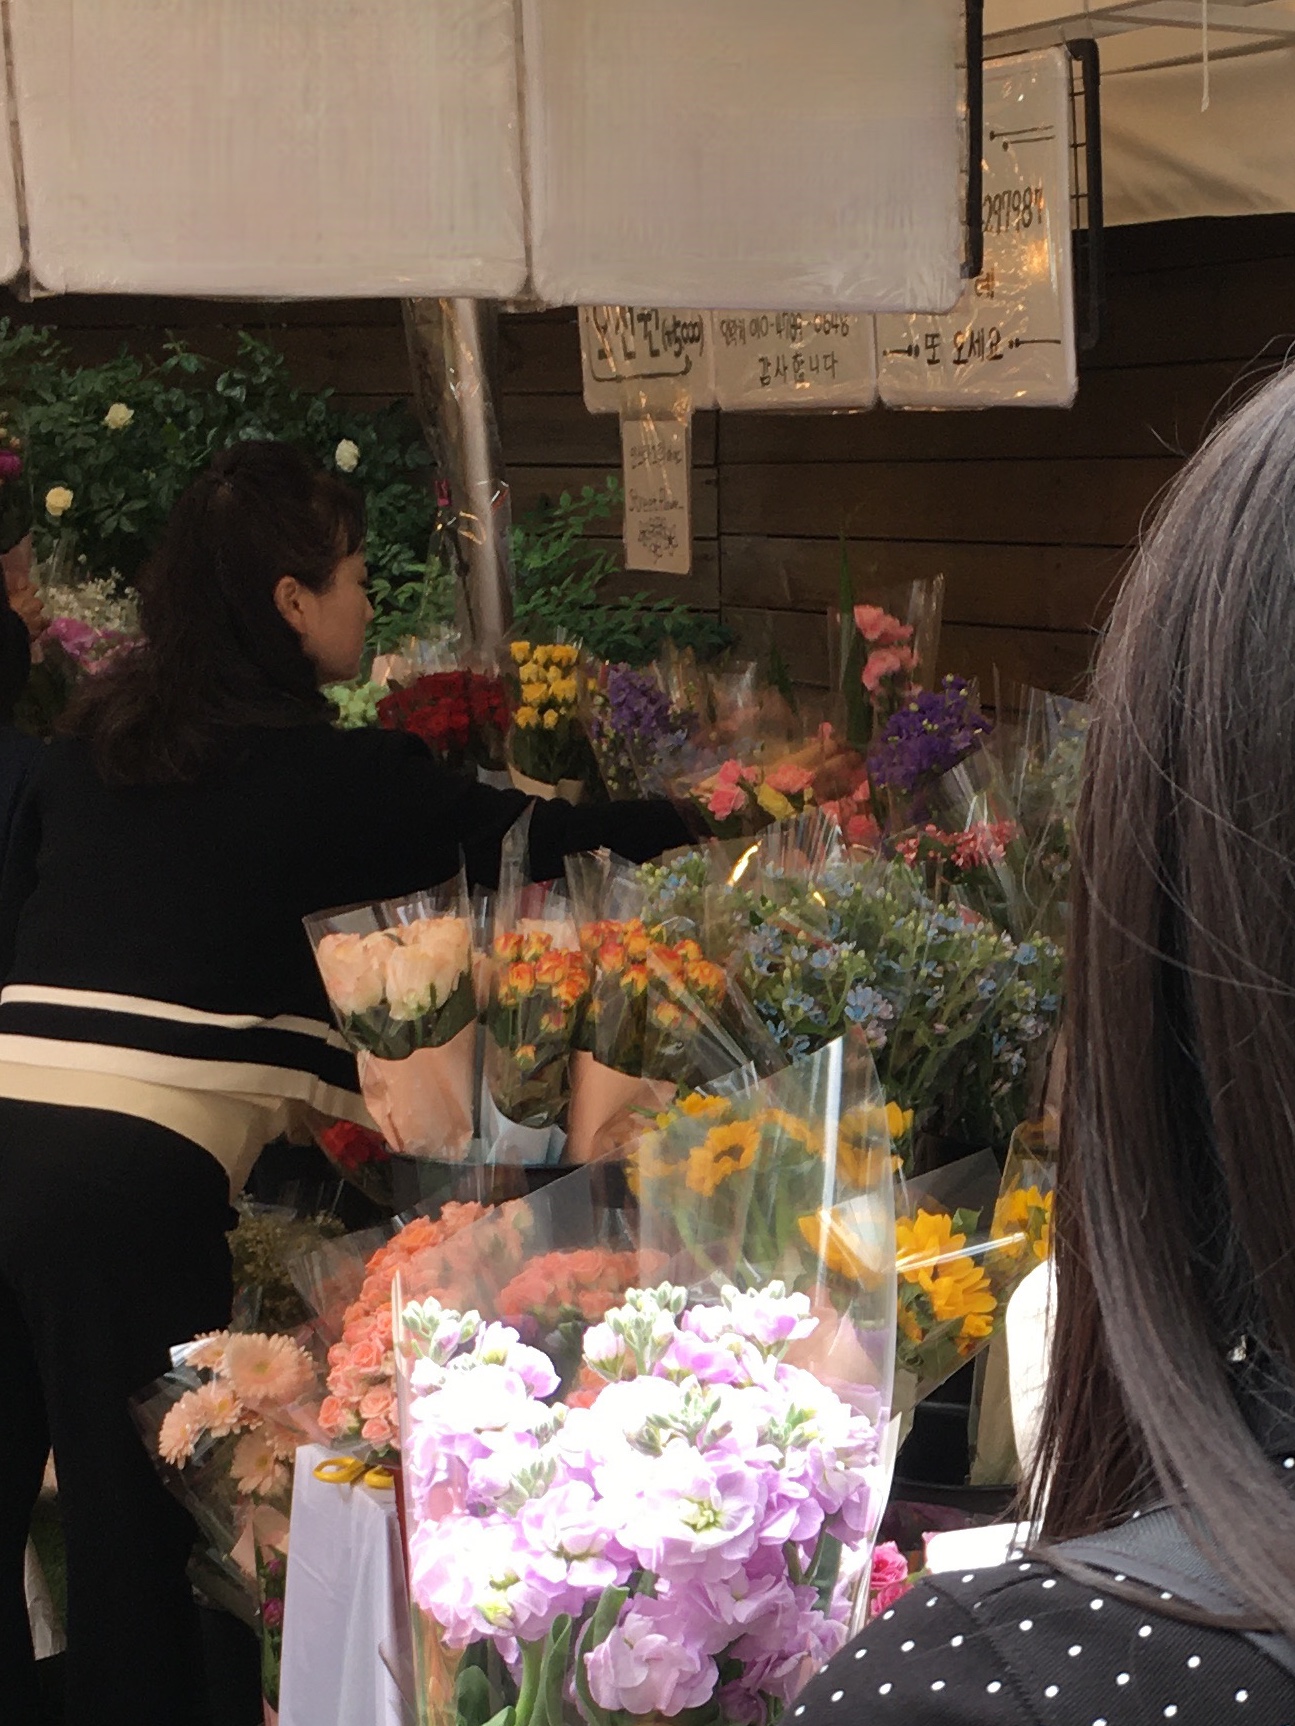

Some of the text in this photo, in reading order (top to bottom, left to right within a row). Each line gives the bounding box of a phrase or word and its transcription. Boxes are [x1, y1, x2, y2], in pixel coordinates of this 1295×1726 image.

[924, 326, 1004, 366] 또 오세요
[758, 350, 839, 387] 감사합니다
